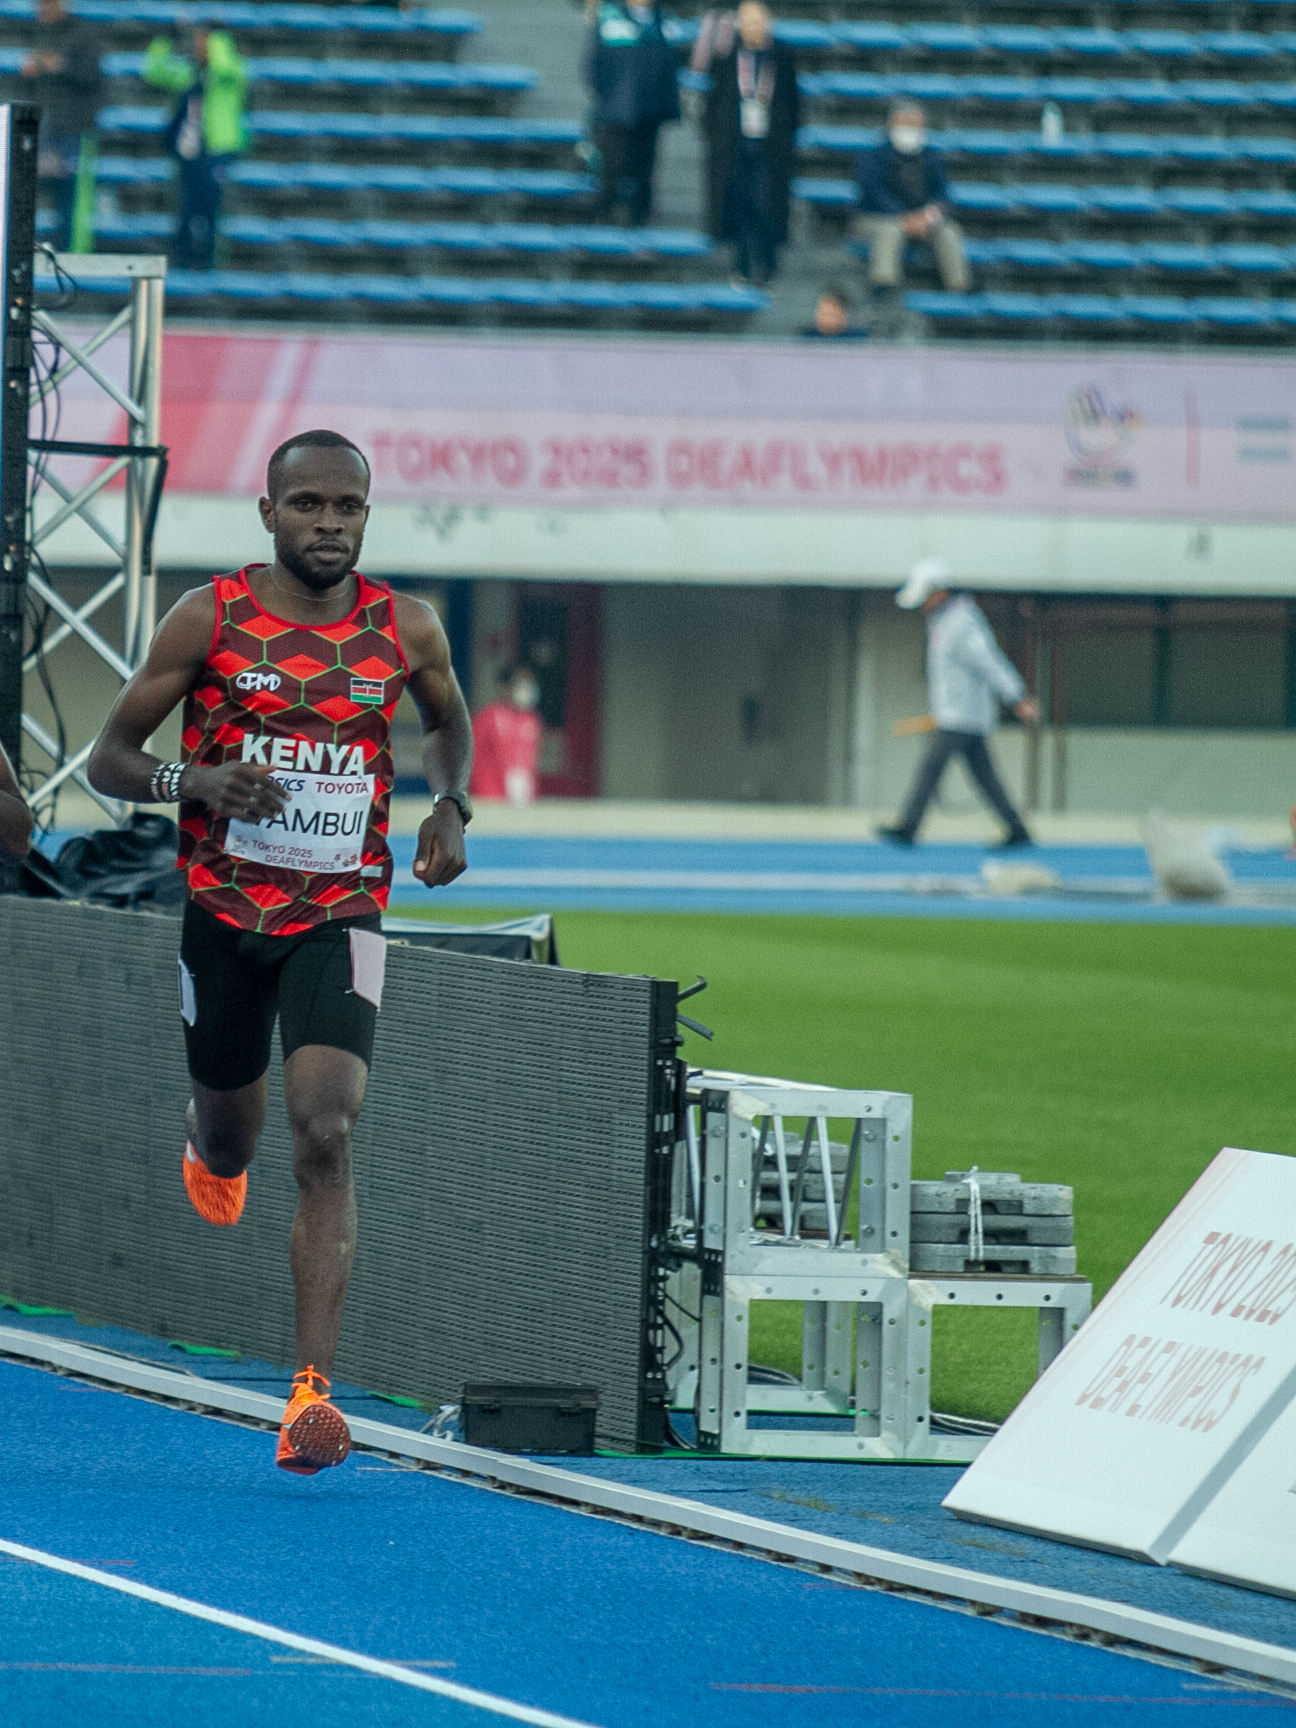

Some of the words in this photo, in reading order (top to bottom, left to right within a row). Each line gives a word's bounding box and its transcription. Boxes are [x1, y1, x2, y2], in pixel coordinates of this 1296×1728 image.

[368, 428, 531, 488] TOKYO
[539, 434, 656, 490] 2025
[664, 436, 1006, 495] DEAFLYMPICS
[241, 734, 365, 775] KENYA
[316, 781, 369, 794] TOYOTA
[256, 808, 364, 836] AMBUI
[252, 840, 285, 854] TOKYO
[288, 846, 313, 858] 2025
[265, 854, 335, 870] DEAFLYMPICS
